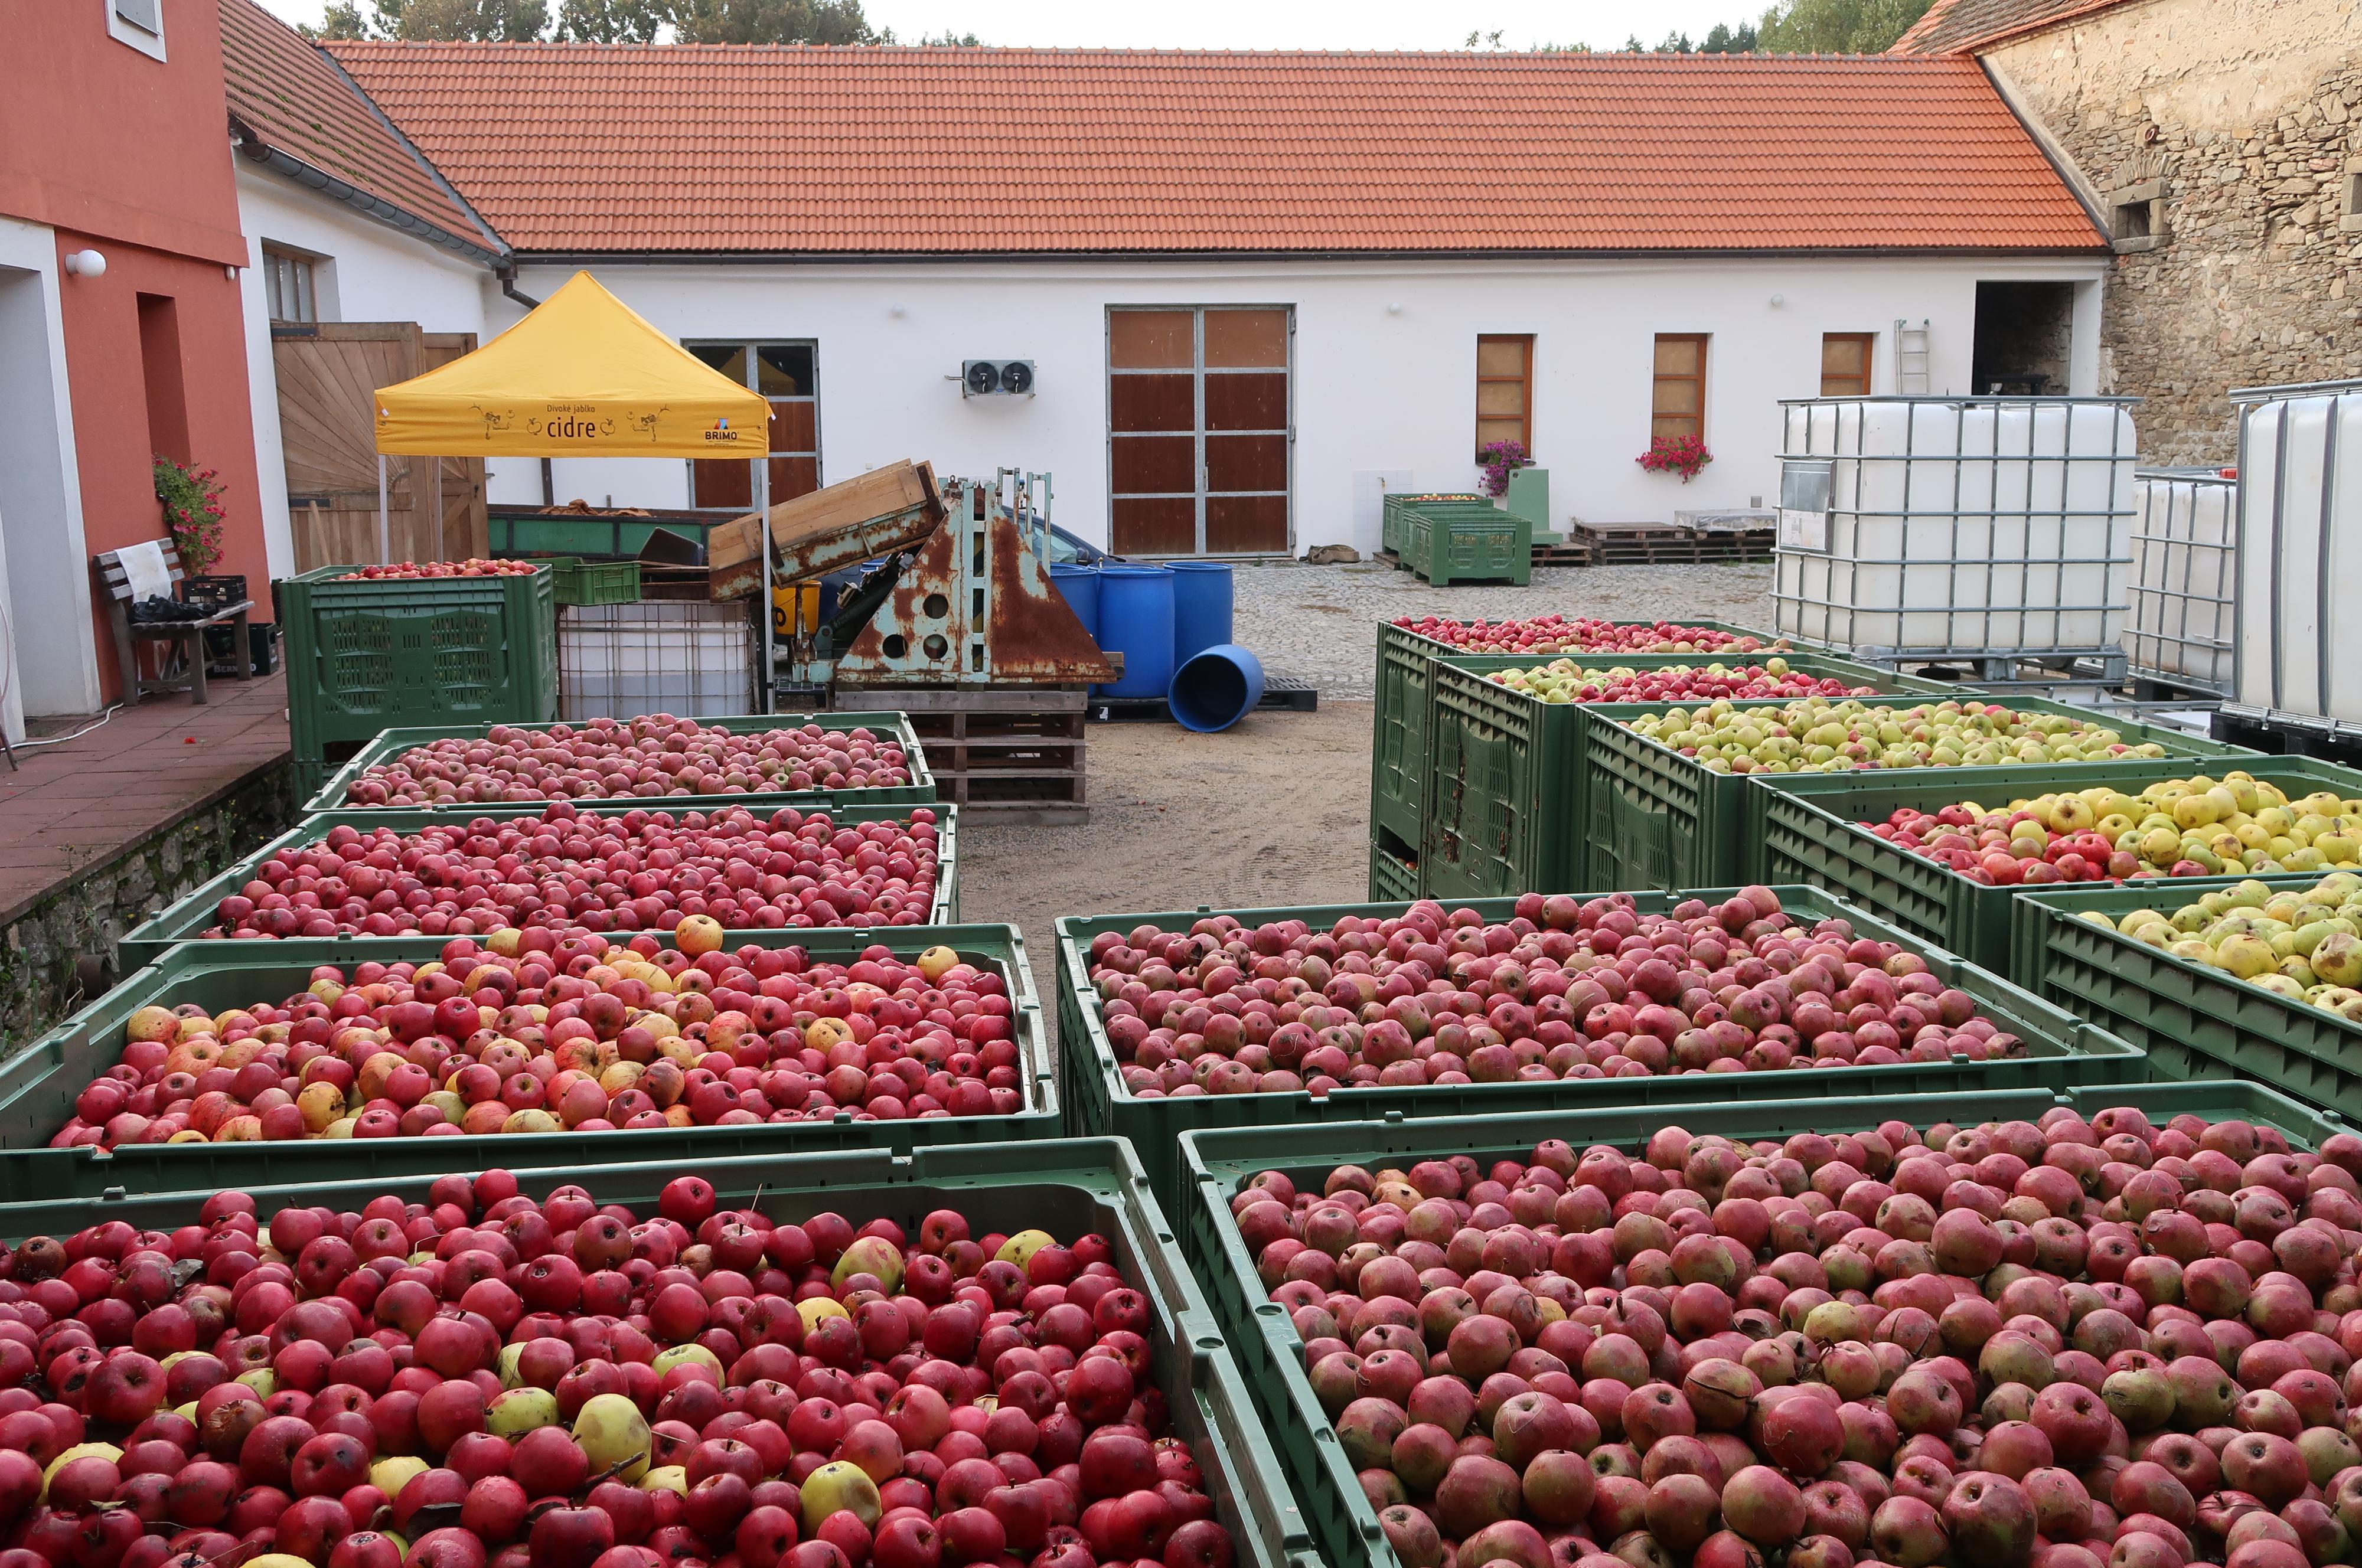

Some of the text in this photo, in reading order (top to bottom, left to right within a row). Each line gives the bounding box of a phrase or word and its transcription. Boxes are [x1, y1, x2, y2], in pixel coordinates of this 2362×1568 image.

[573, 404, 595, 414] jablko
[547, 416, 595, 437] cidre
[705, 432, 737, 440] BRIMO
[214, 663, 256, 672] BERND
